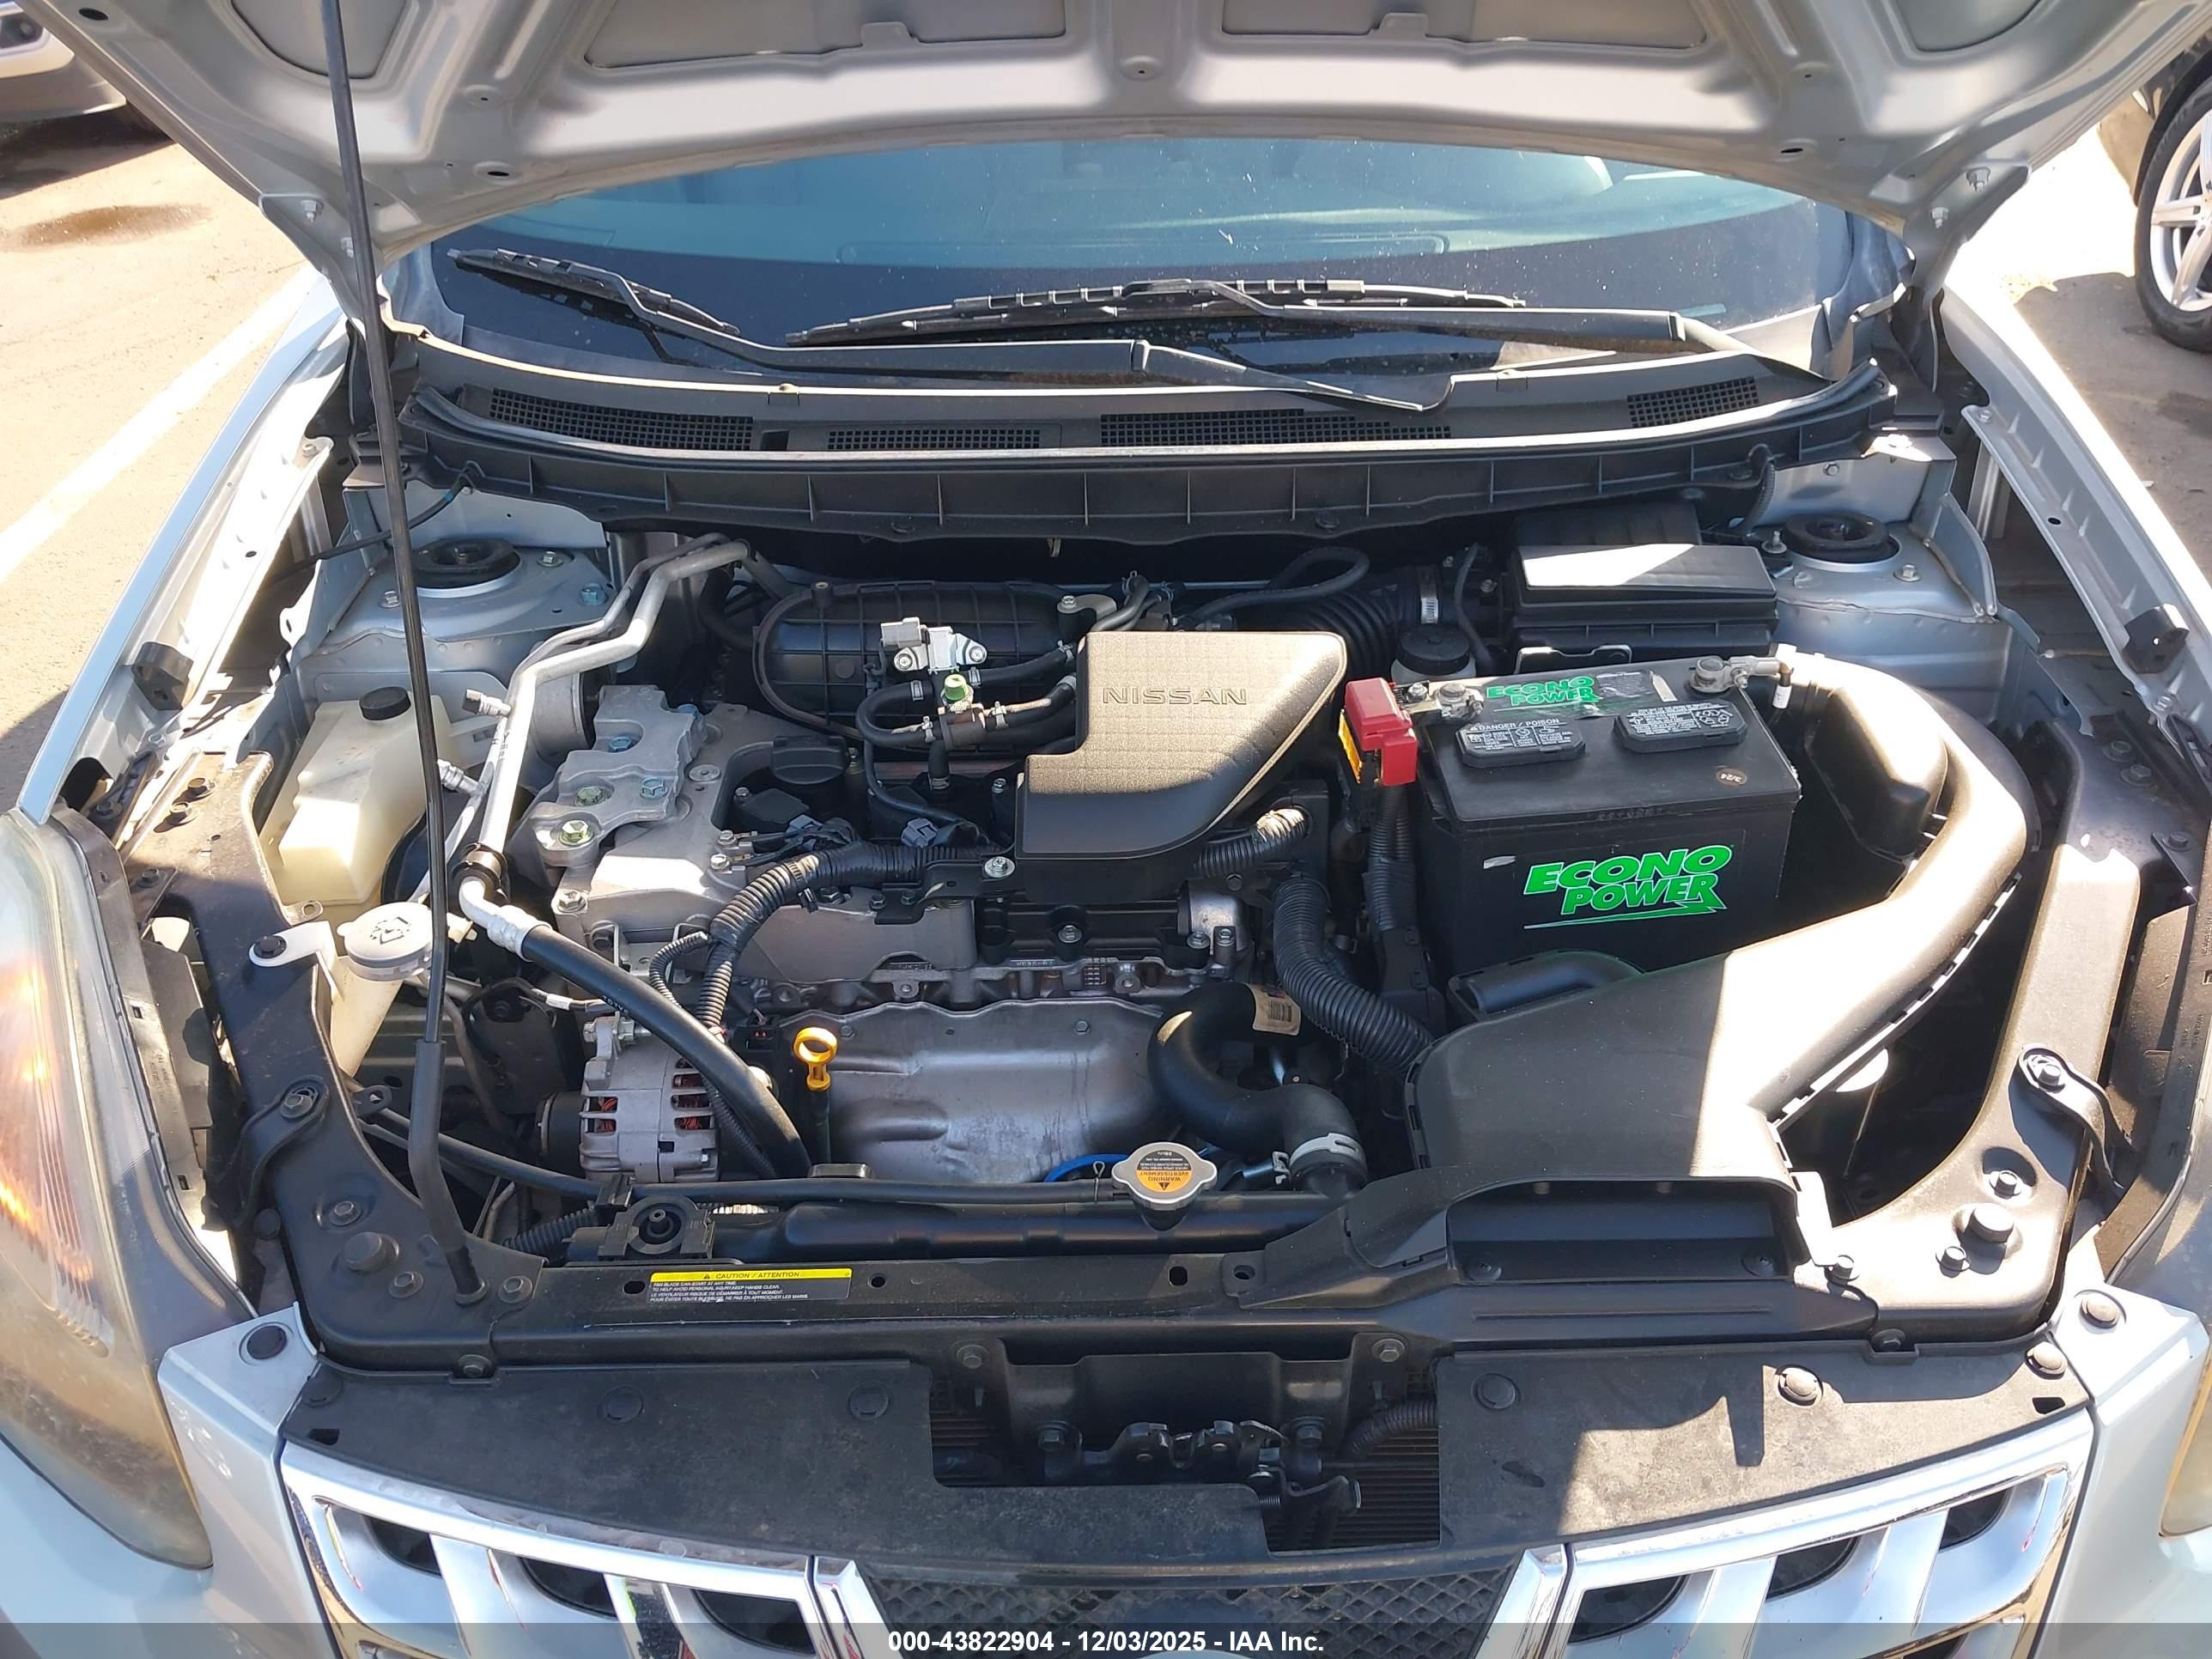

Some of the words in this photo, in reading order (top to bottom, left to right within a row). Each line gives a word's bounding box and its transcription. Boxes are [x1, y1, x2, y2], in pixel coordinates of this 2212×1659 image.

[1103, 687, 1247, 705] NISSAN
[1486, 675, 1595, 699] ECONO
[1478, 722, 1516, 731] DANGER
[1526, 718, 1560, 726] POISON
[1523, 845, 1733, 895] ECONO
[1560, 873, 1728, 915] POWER
